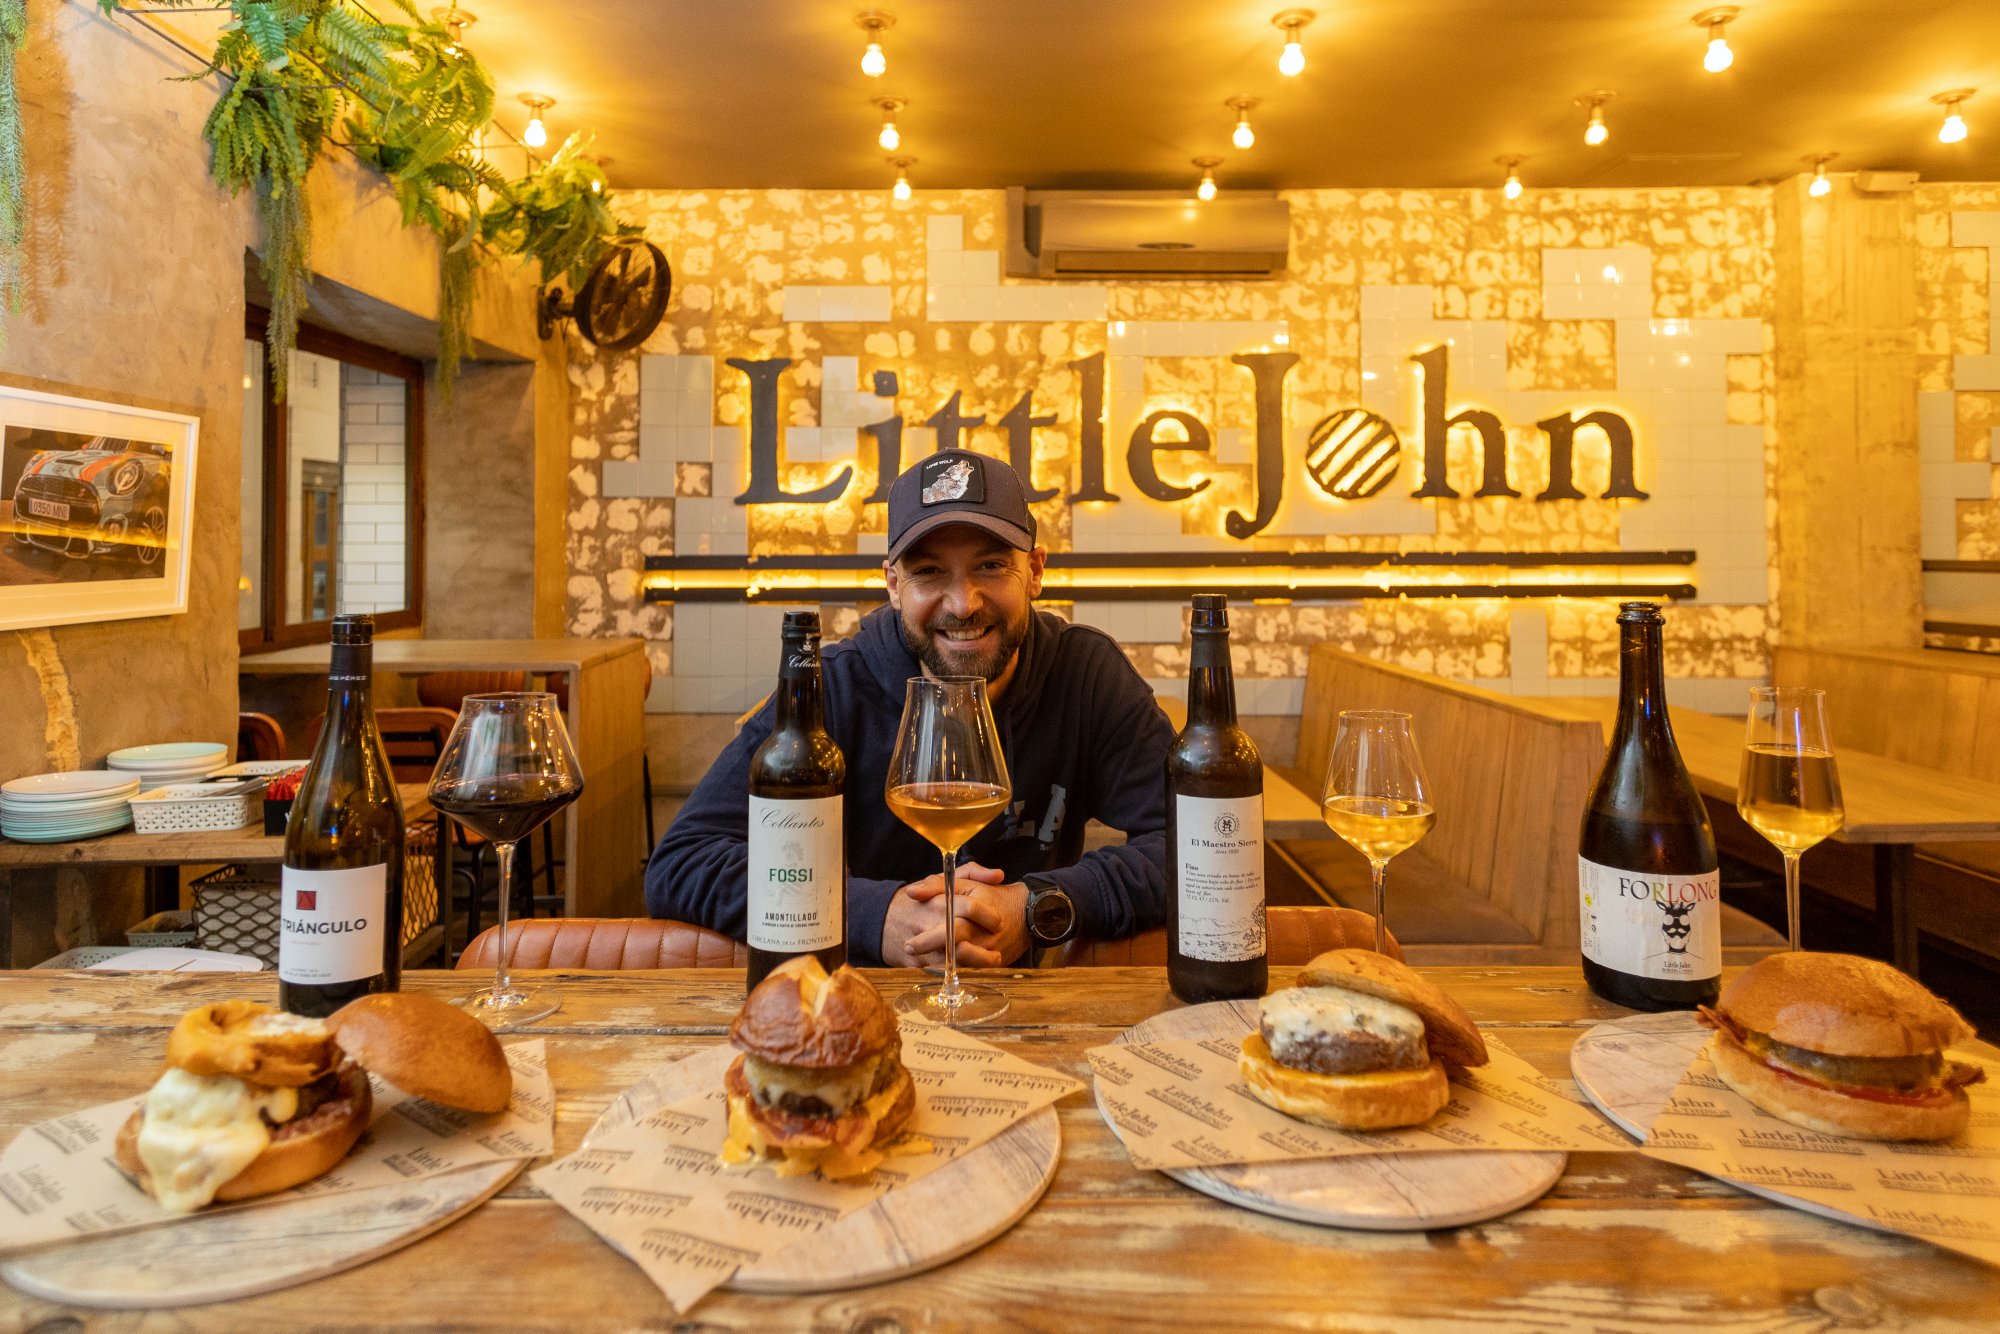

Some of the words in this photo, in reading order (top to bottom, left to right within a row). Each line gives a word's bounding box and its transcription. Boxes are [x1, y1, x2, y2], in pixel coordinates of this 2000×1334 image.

[760, 808, 824, 828] Collantes
[1191, 838, 1200, 846] El
[1202, 840, 1236, 848] Maestro
[1238, 838, 1258, 846] Sierra
[769, 868, 813, 882] FOSSI
[1619, 878, 1717, 903] FORLONG
[764, 912, 818, 922] AMONTILLADO
[282, 918, 367, 935] TRIÁNGULO
[798, 935, 832, 946] FRONTERA
